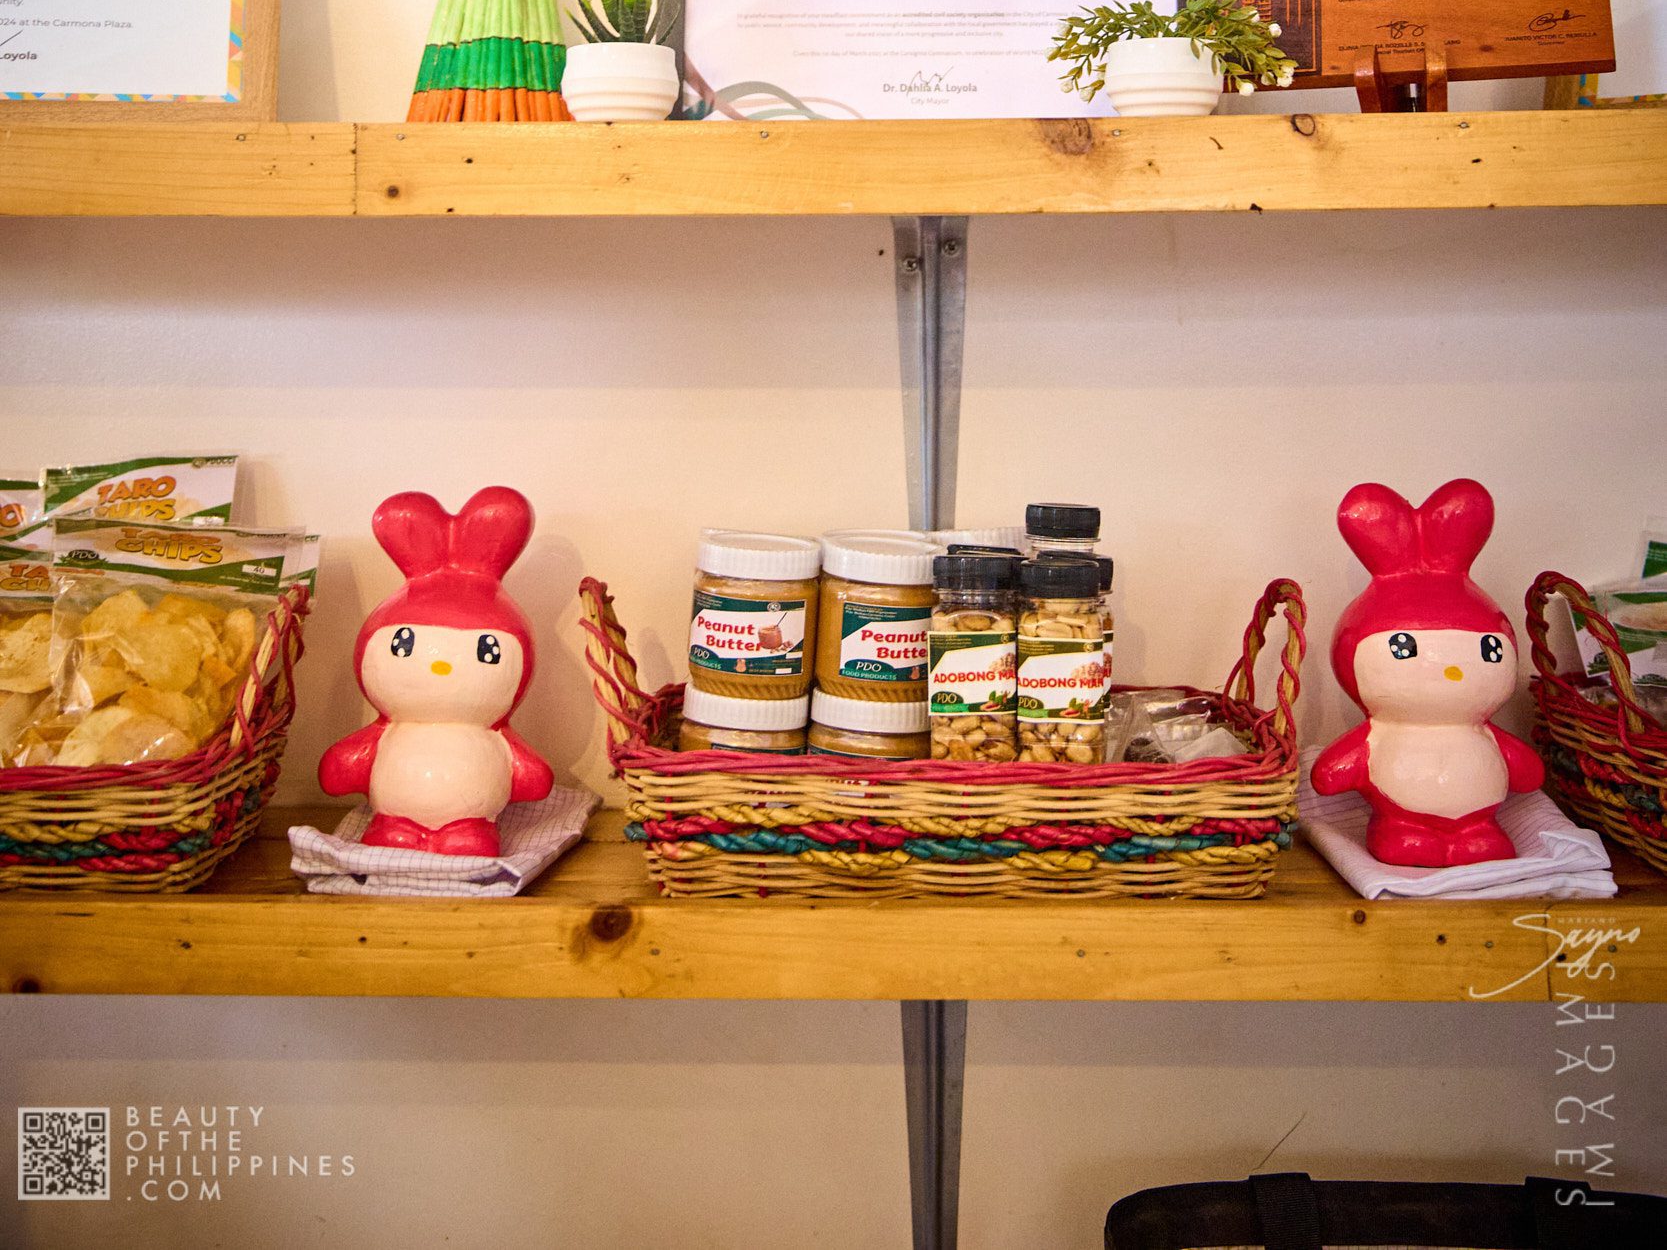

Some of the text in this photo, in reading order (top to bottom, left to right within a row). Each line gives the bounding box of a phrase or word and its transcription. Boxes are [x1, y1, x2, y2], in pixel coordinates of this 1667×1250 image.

[19, 19, 30, 28] at
[32, 19, 50, 28] the
[52, 19, 102, 29] Carmona
[104, 20, 133, 30] Plaza.
[883, 84, 898, 93] Dr.
[946, 83, 978, 94] Loyola
[97, 475, 177, 506] TARO
[115, 538, 223, 565] CHIPS
[9, 562, 49, 579] TA
[697, 616, 756, 636] Peanut
[706, 634, 762, 651] Butter
[861, 629, 928, 643] Peanut
[876, 646, 928, 659] Butte
[855, 661, 882, 672] PDO
[933, 671, 996, 684] ADOBONG
[937, 692, 958, 705] PDO
[1018, 698, 1038, 710] PDO
